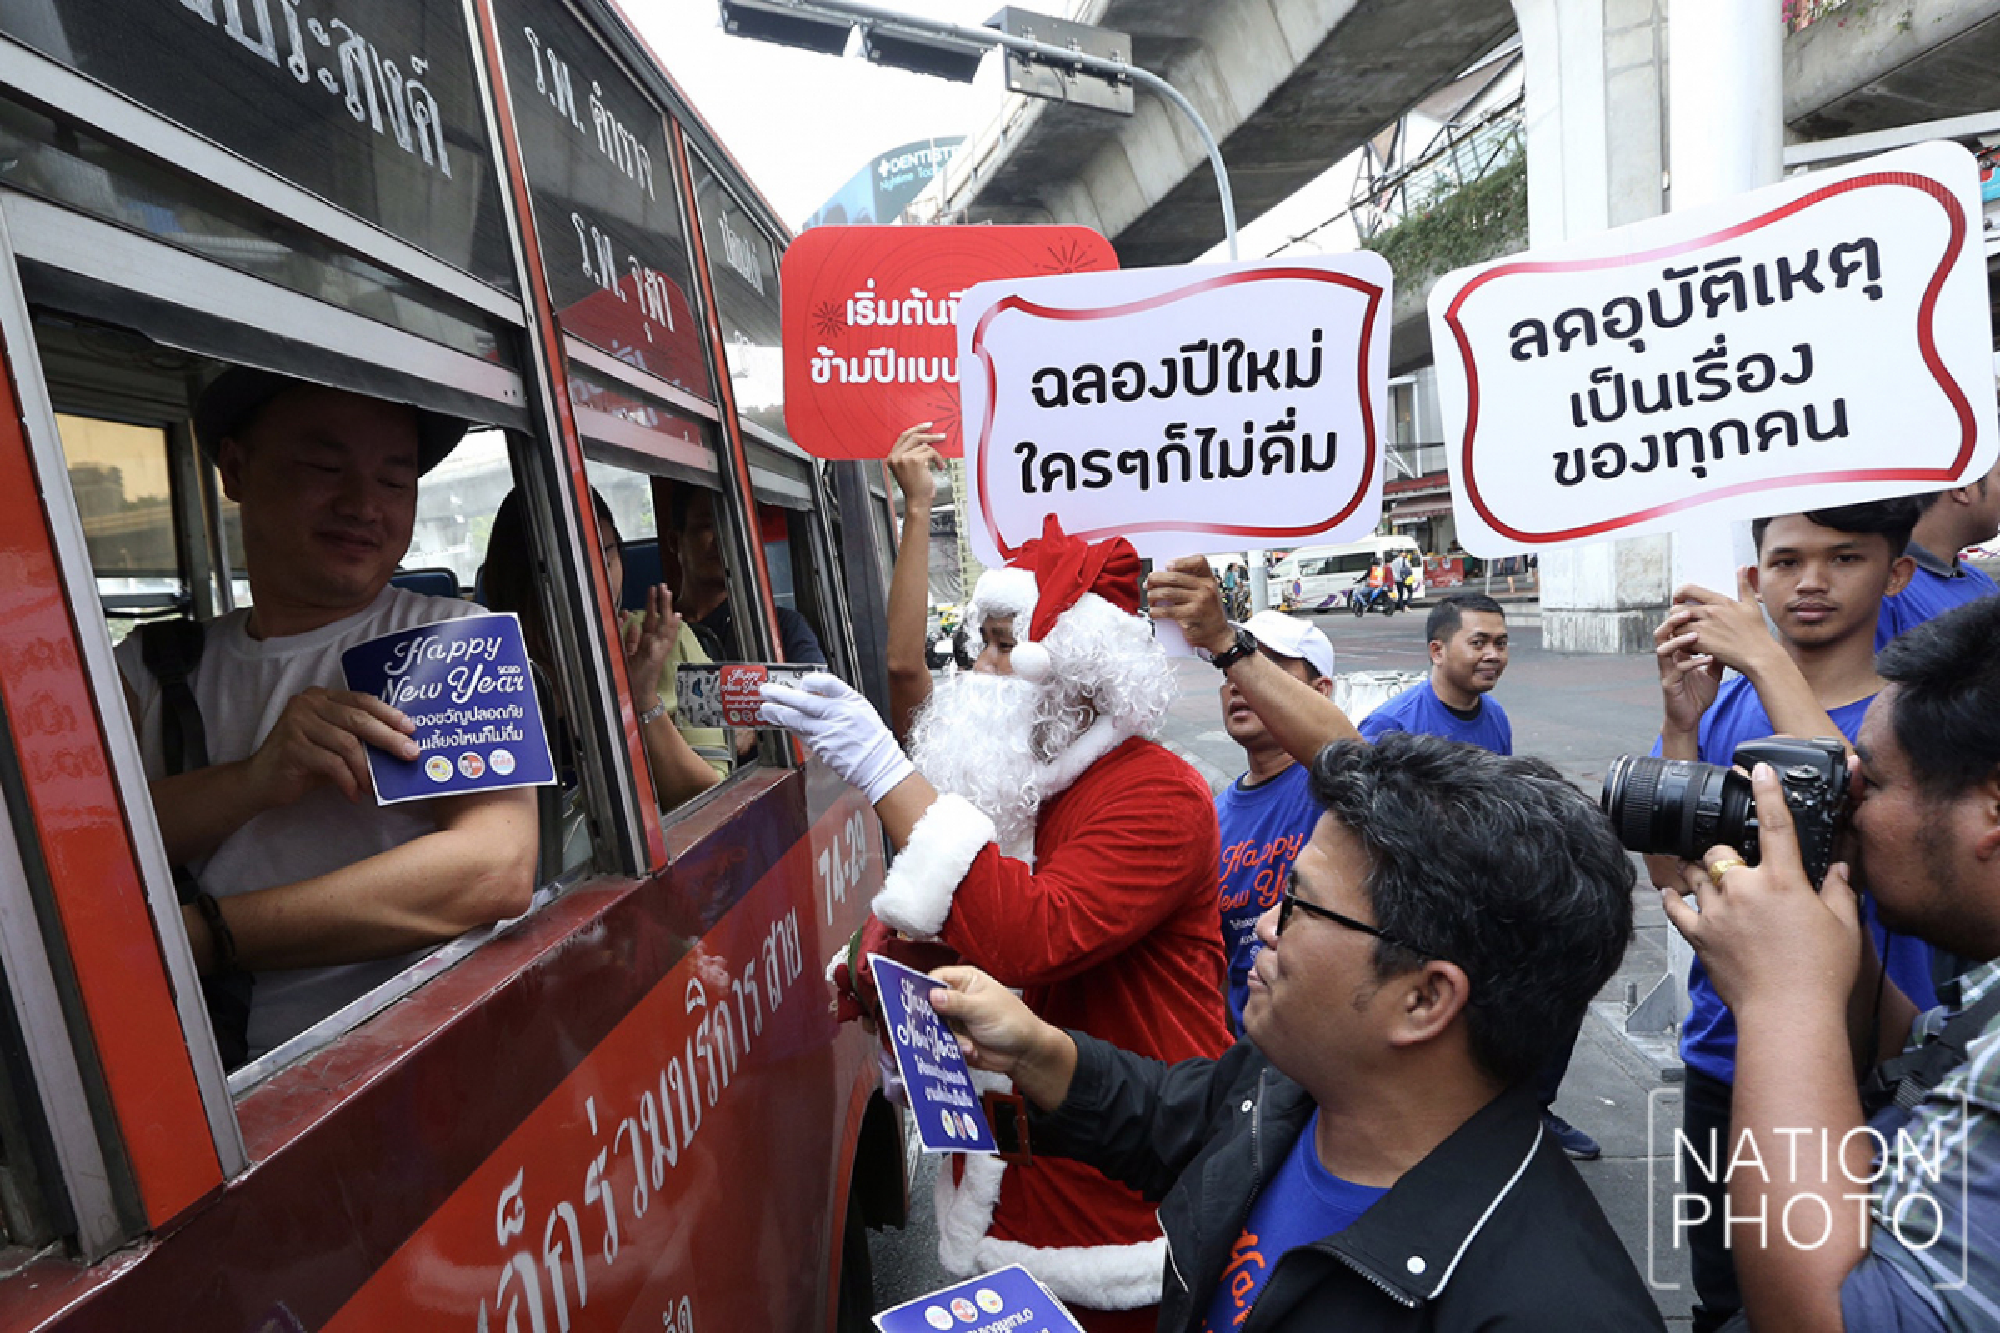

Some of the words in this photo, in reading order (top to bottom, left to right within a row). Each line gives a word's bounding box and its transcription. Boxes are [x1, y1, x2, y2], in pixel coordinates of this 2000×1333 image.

[179, 0, 452, 179] ประสงค์
[1508, 236, 1884, 361] ลดอุบัติเหตุ
[810, 346, 960, 384] ข้ามปีแบบ
[1031, 327, 1324, 408] ฉลองปีใหม่
[1570, 333, 1814, 428] เป็นเรื่อง
[1014, 407, 1338, 493] ใครๆก็ไม่ดื่ม
[1552, 397, 1850, 487] ของทุกคน
[381, 675, 443, 707] New
[447, 663, 524, 704] Year
[384, 635, 503, 676] Happy
[1218, 833, 1304, 883] Happy
